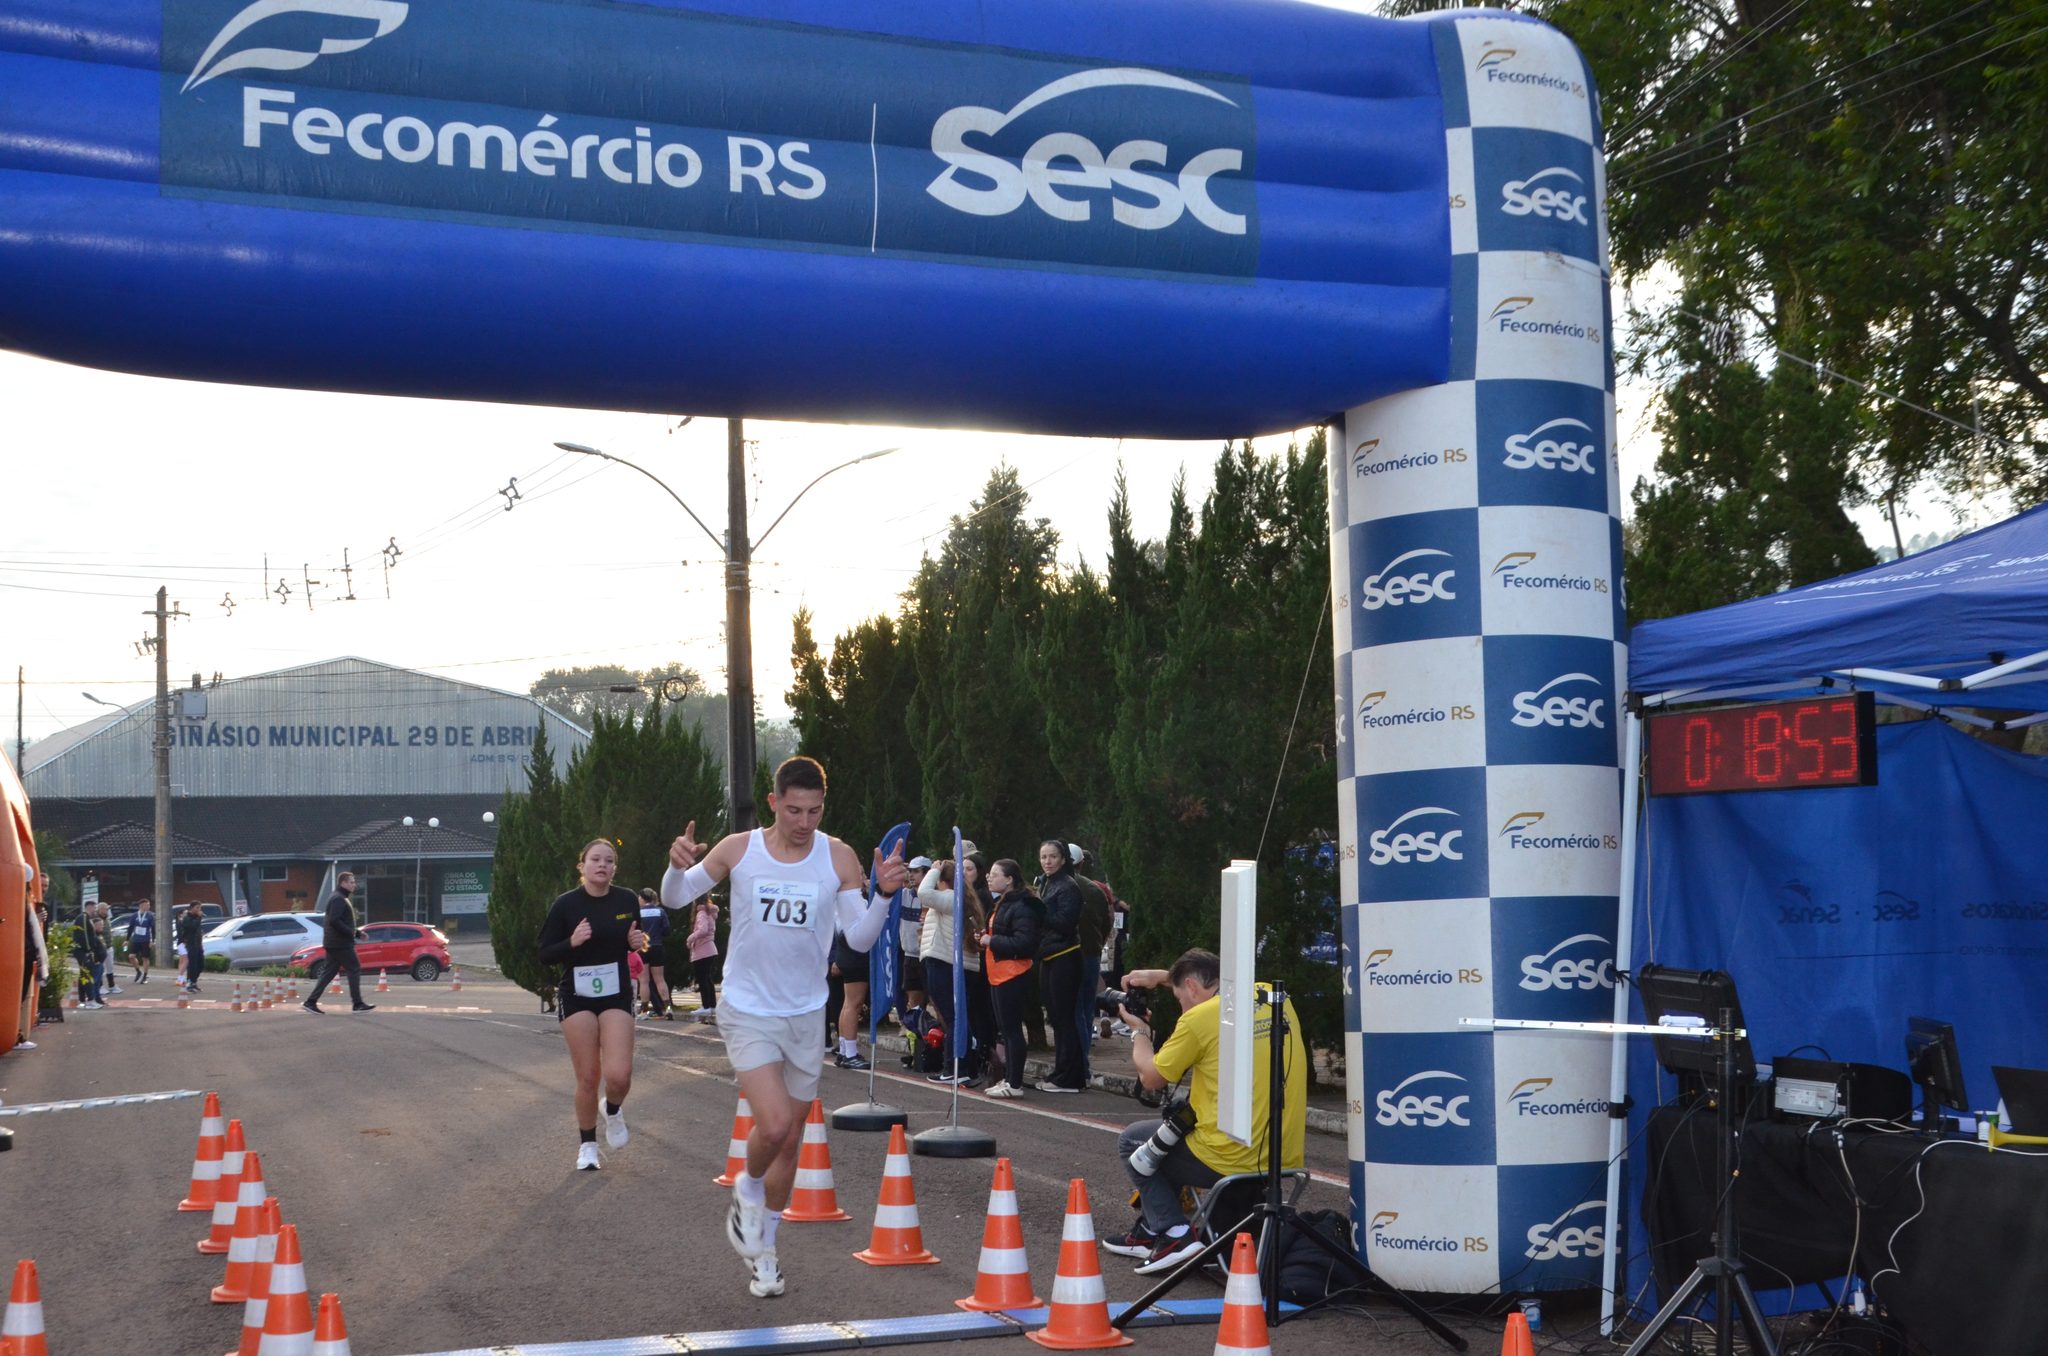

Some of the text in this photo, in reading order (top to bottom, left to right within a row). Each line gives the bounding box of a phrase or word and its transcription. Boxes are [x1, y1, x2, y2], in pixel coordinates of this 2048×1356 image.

[1487, 69, 1585, 98] Fecomércio RS
[243, 86, 827, 200] Fecomércio RS
[926, 67, 1247, 235] Sesc
[1501, 167, 1588, 225] Sesc
[1500, 318, 1600, 344] Fecomércio RS
[1503, 418, 1595, 475] Sesc
[1356, 448, 1467, 478] Fecomércio RS
[1362, 549, 1456, 610] Sesc
[1503, 574, 1591, 591] Fecomércio
[1594, 577, 1608, 593] RS
[1511, 673, 1604, 729] Sesc
[1362, 709, 1445, 729] Fecomércio
[1451, 705, 1475, 721] RS
[269, 726, 400, 747] MUNICIPAL
[408, 726, 438, 747] 29
[446, 726, 474, 747] DE
[1685, 703, 1858, 787] 0:18:53
[1369, 807, 1463, 865] Sesc
[1511, 833, 1617, 850] Fecomércio RS
[760, 898, 807, 925] 703
[1370, 970, 1452, 986] Fecomércio
[1458, 968, 1482, 984] RS
[1518, 934, 1614, 991] Sesc
[592, 978, 603, 994] 9
[1376, 1071, 1470, 1127] Sesc
[1519, 1099, 1609, 1116] Fecomércio
[1375, 1235, 1458, 1252] Fecomércio
[1464, 1237, 1488, 1252] RS
